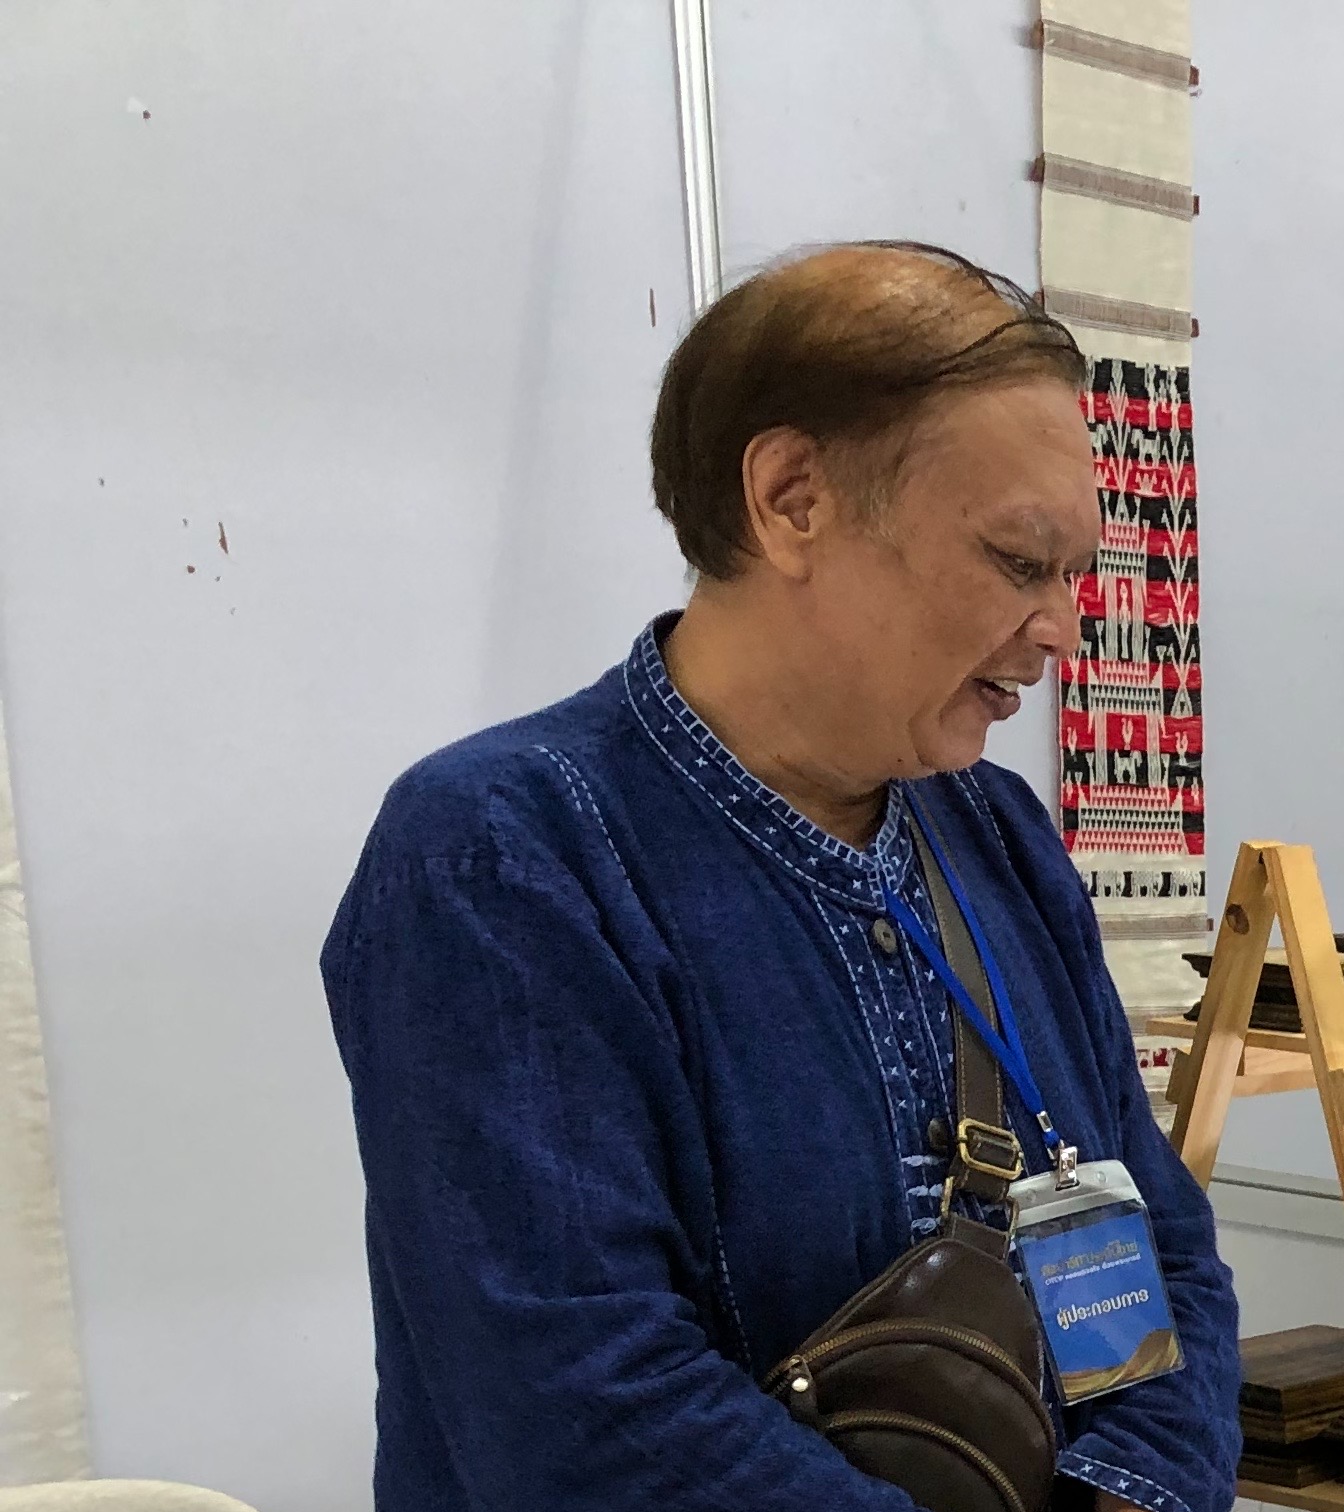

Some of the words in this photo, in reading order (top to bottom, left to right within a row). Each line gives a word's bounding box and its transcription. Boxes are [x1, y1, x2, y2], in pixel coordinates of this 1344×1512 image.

[1056, 1288, 1149, 1331] ผู้ประกอบการ
